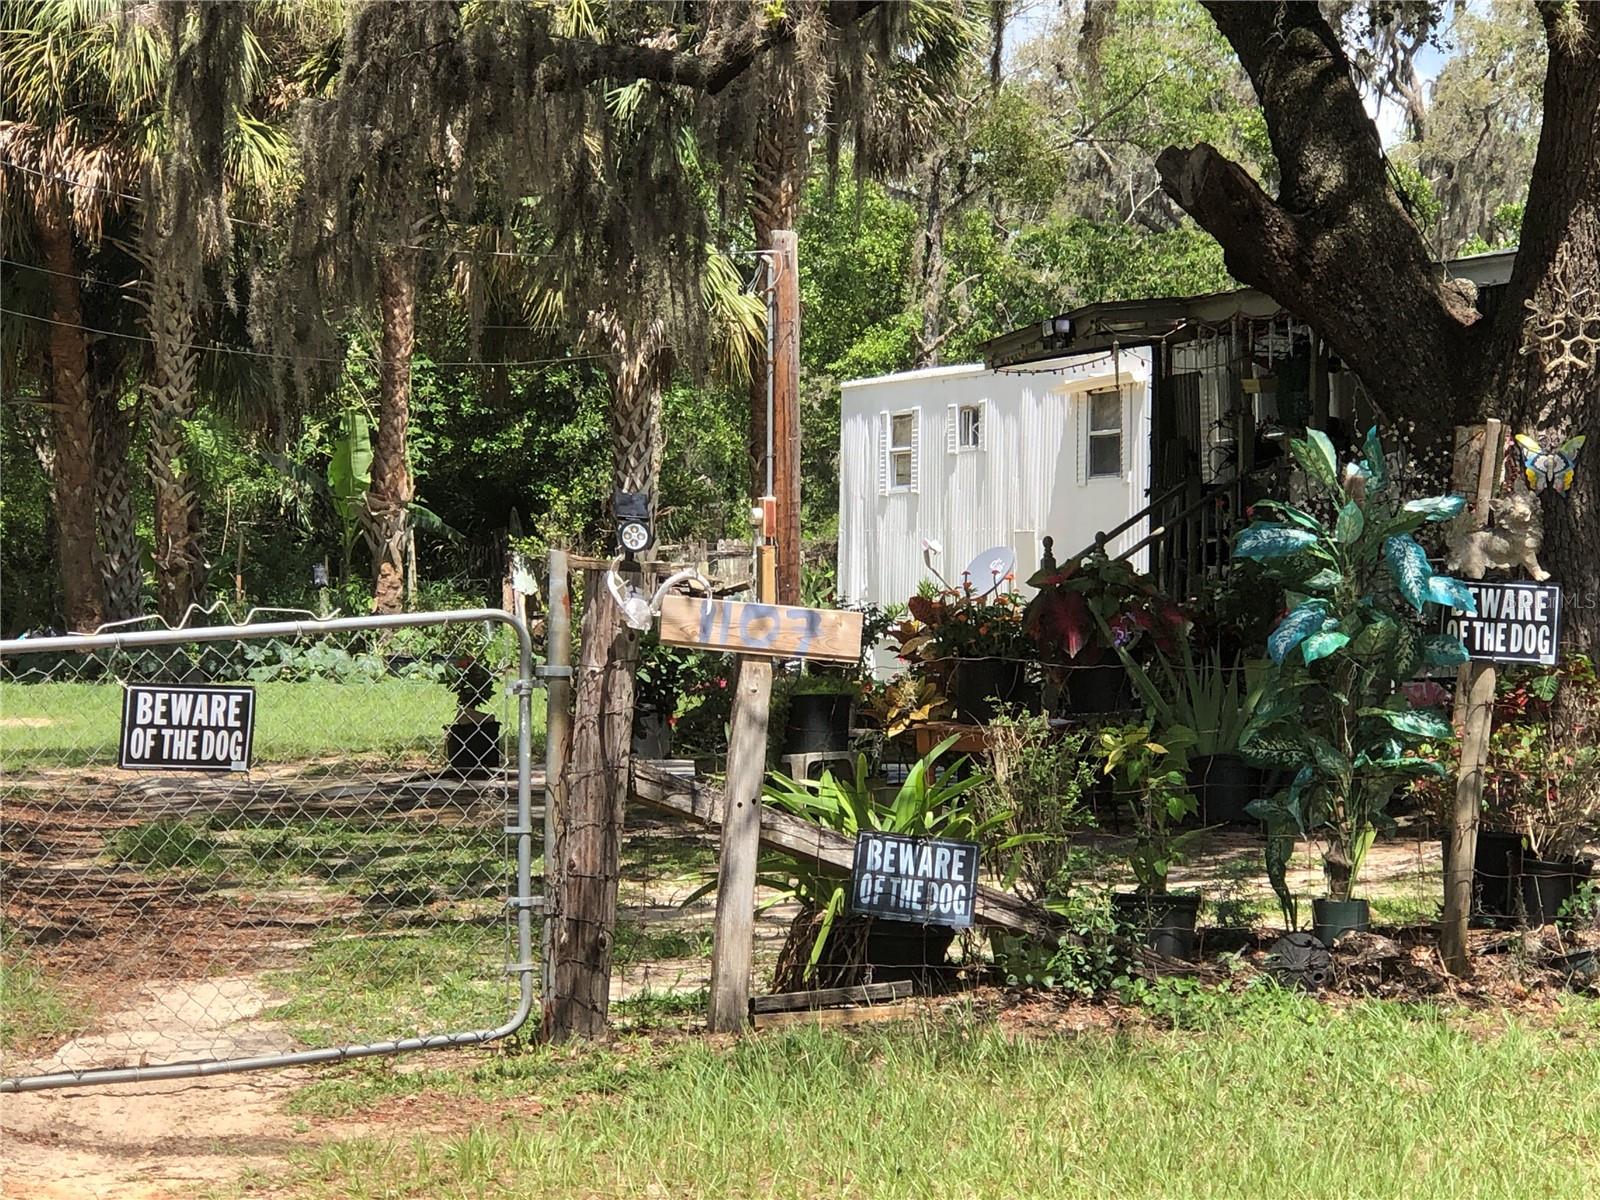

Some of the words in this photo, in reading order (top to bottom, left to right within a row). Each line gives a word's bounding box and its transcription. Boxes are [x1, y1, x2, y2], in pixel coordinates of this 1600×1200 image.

[1451, 587, 1549, 622] EWARE
[700, 600, 822, 656] 1107
[1473, 621, 1507, 653] THE
[1509, 623, 1551, 655] DOG
[136, 692, 243, 728] BEWARE
[130, 727, 157, 760] OF
[161, 729, 199, 760] THE
[201, 730, 243, 762] DOG
[866, 839, 967, 882] BEWARE
[860, 873, 886, 905] OF
[889, 876, 924, 911] THE
[925, 881, 967, 916] DOG
